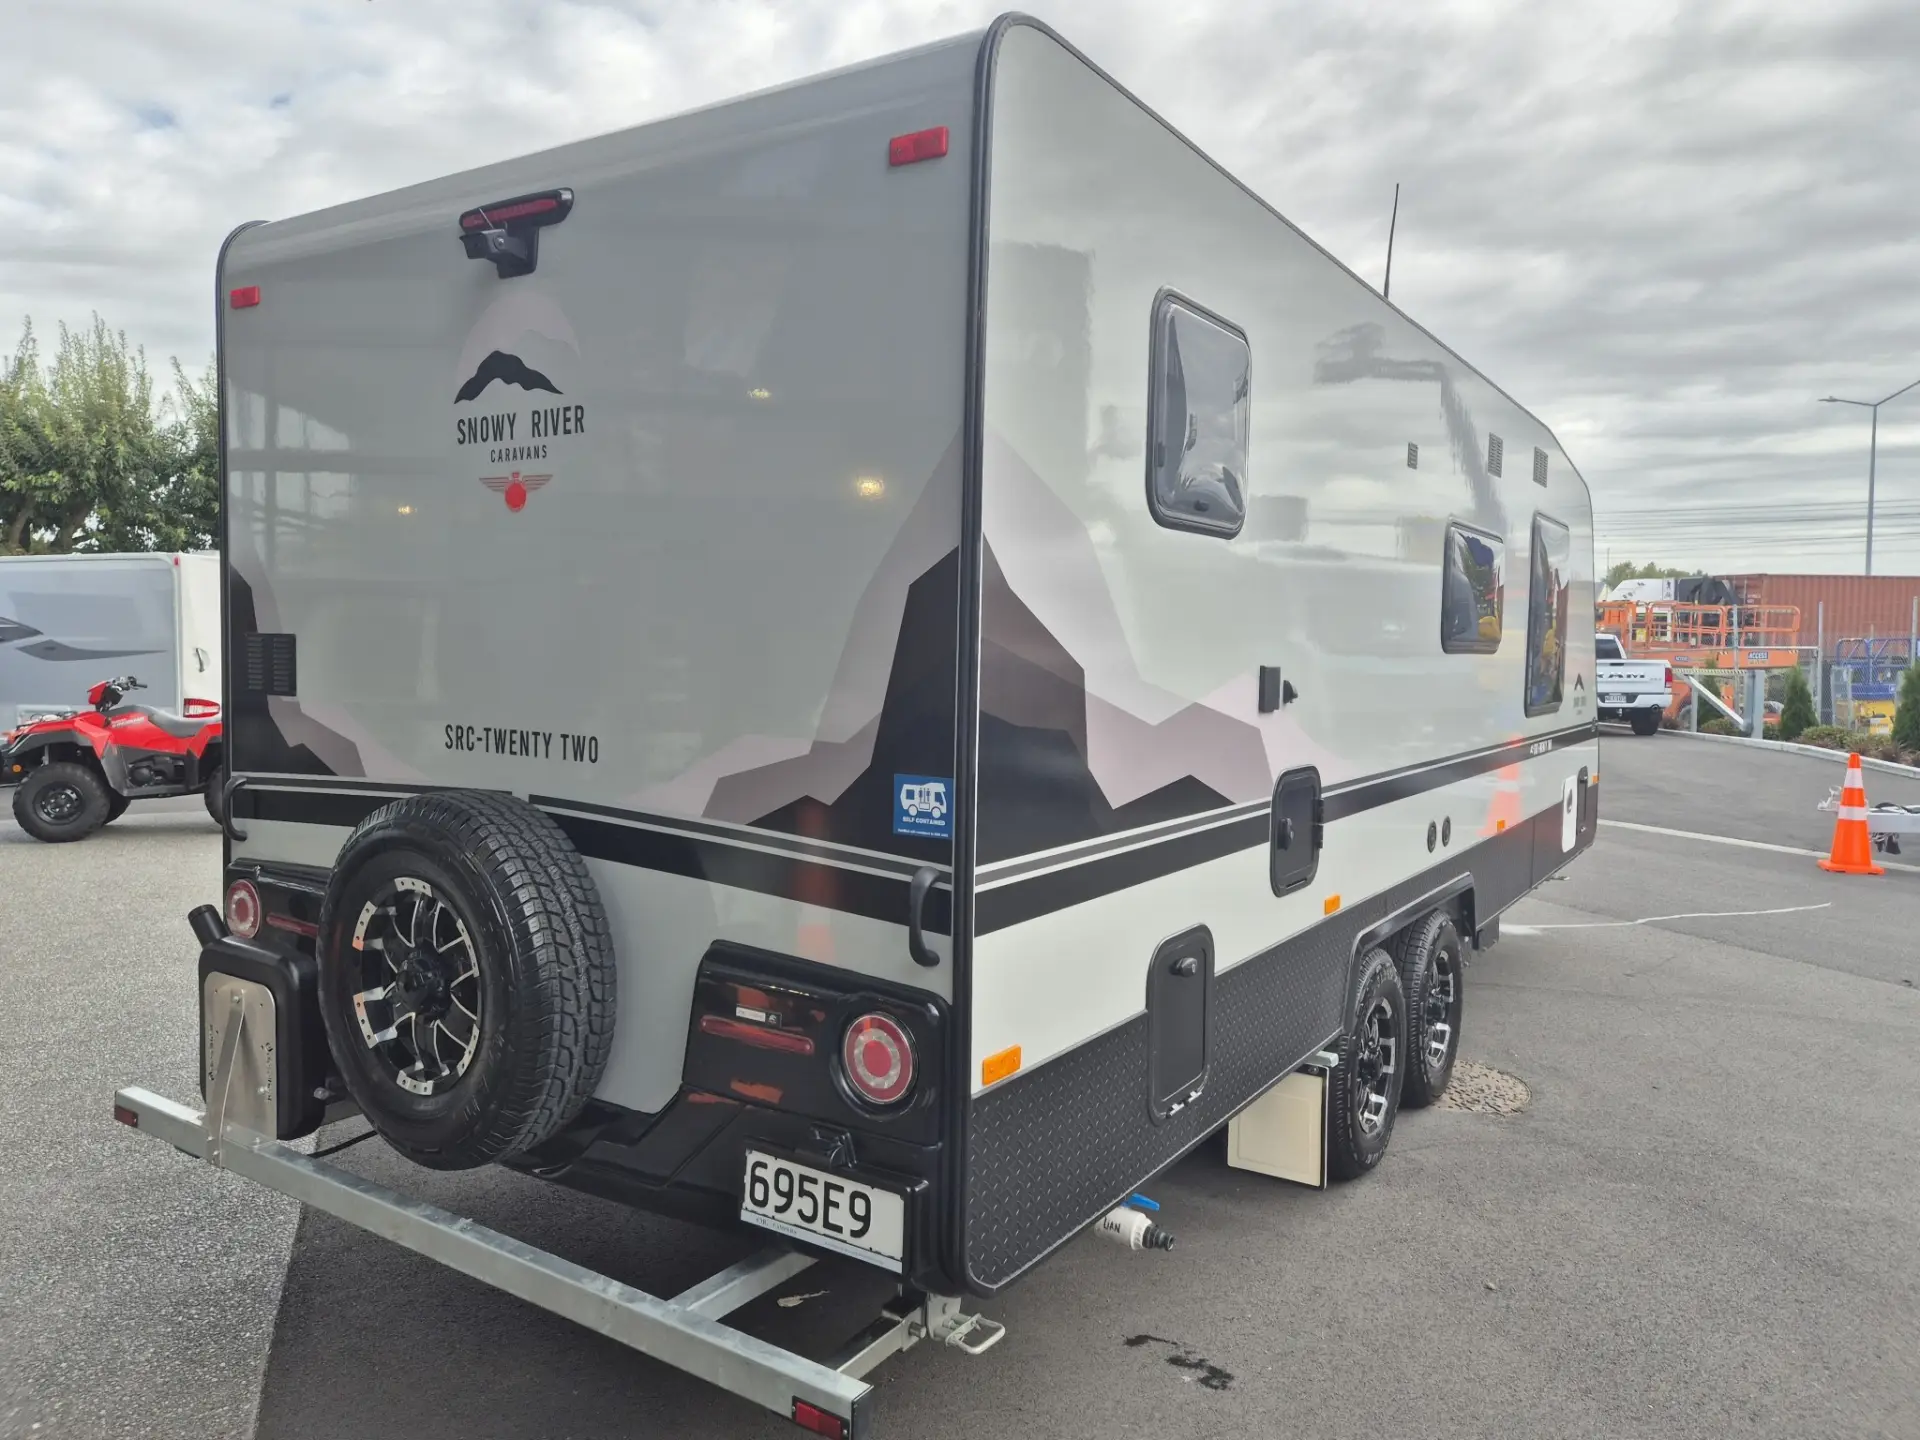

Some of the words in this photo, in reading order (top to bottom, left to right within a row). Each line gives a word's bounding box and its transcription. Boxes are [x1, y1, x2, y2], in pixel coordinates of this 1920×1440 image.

[457, 412, 516, 445] SNOWY
[532, 405, 585, 438] RIVER
[490, 444, 547, 463] CARAVANS
[445, 724, 552, 759] SRC-TWENTY
[560, 733, 599, 764] TWO
[749, 1160, 872, 1239] 695E9
